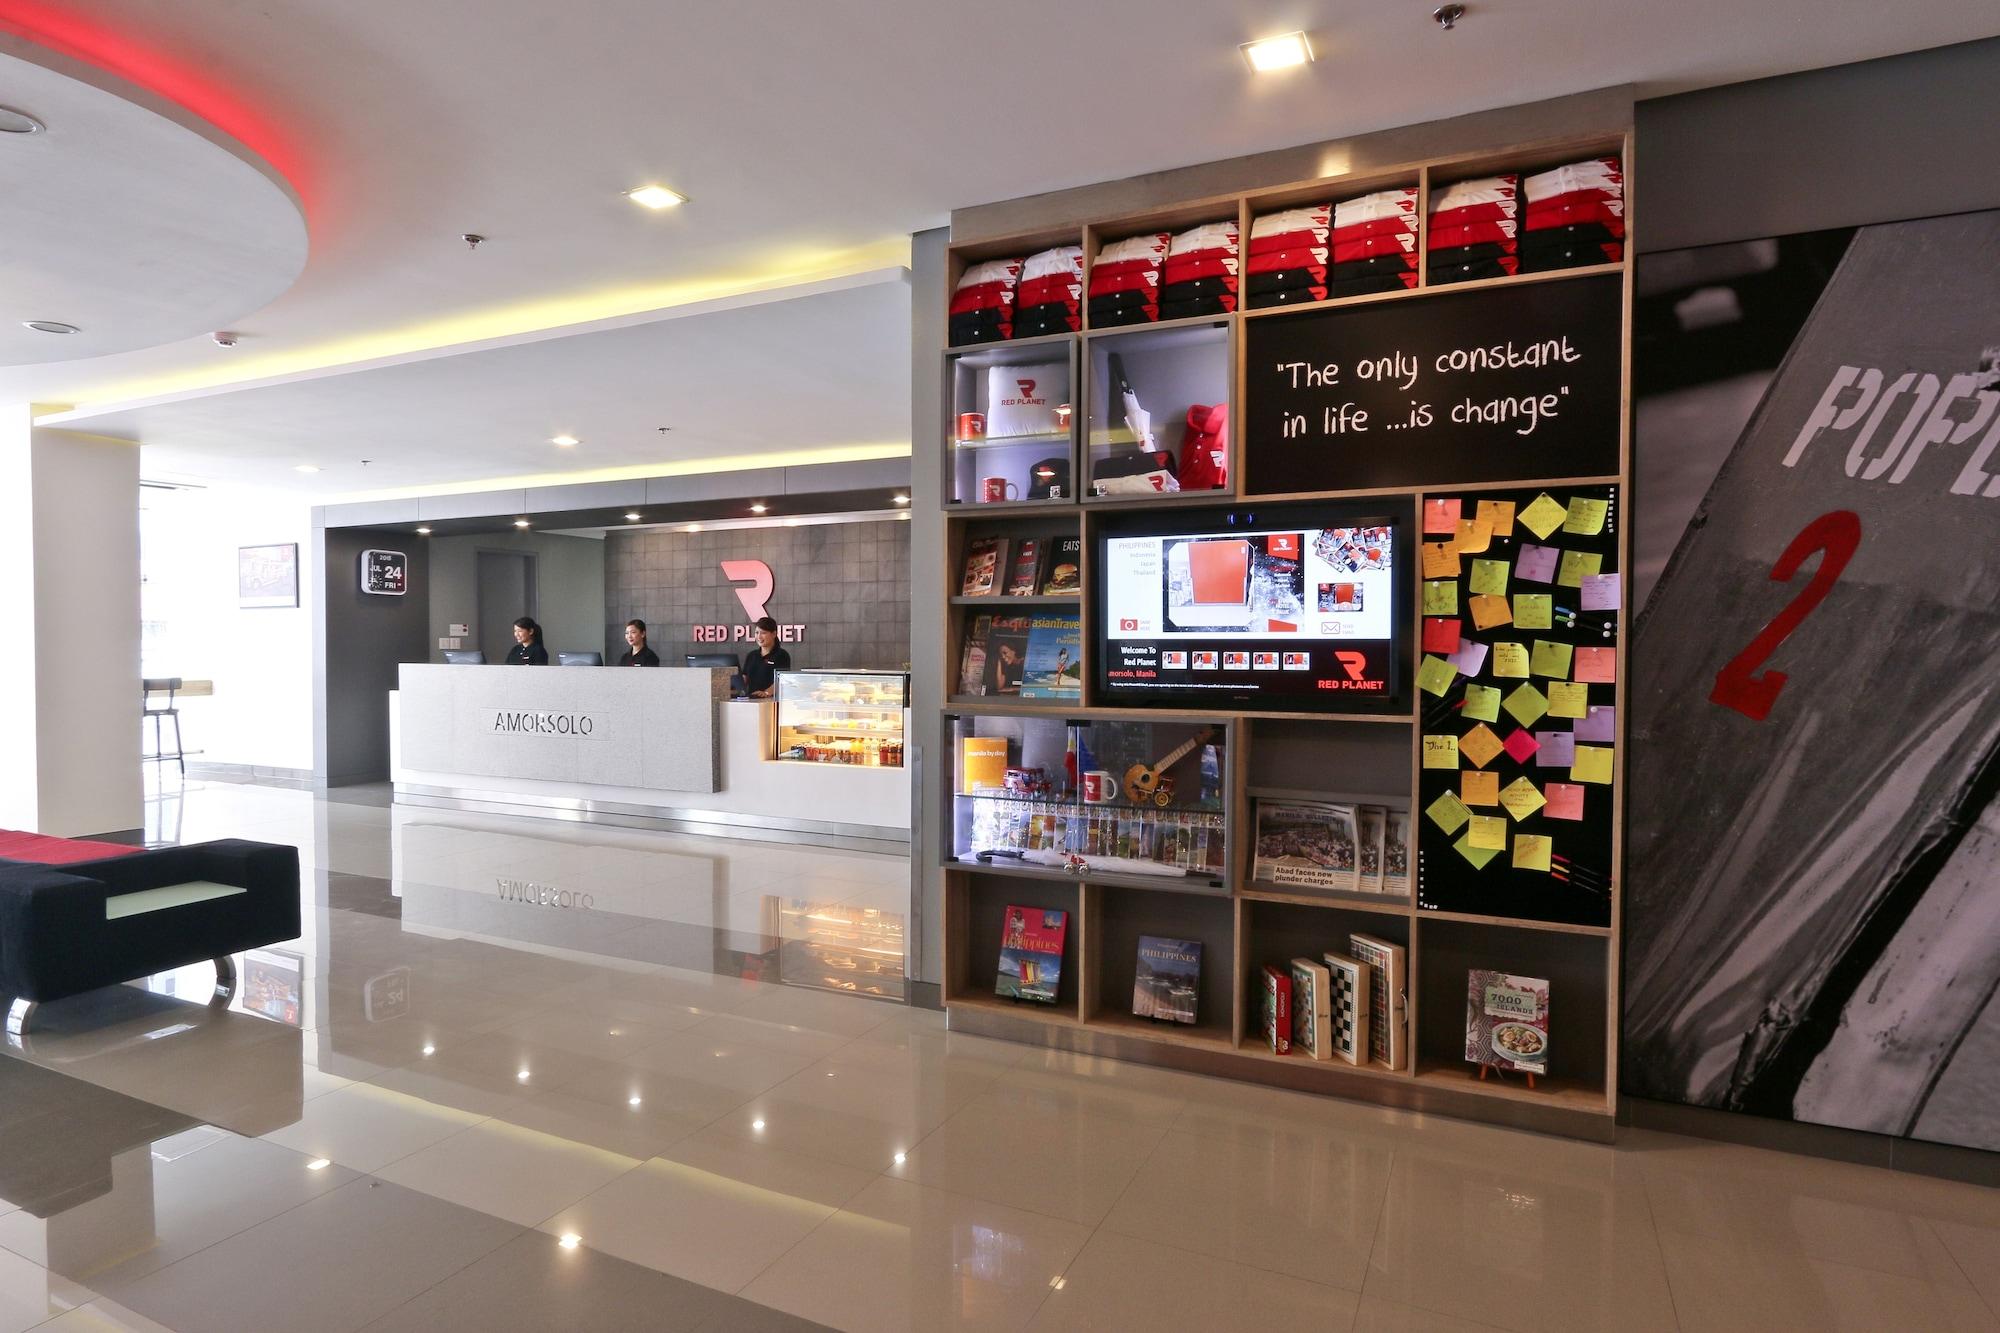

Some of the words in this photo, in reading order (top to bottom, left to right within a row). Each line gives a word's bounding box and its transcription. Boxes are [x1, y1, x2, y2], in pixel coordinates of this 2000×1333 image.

[1357, 350, 1418, 390] only
[1436, 335, 1581, 372] constant
[1017, 398, 1046, 406] PLANET
[1282, 411, 1306, 437] in
[1324, 402, 1368, 434] life
[1063, 541, 1080, 551] EATS
[385, 566, 402, 579] 24
[1709, 510, 1862, 721] 2
[693, 625, 728, 642] RED
[734, 624, 806, 643] PLNET
[1124, 658, 1136, 666] Red
[1137, 658, 1156, 666] Planet
[1108, 670, 1135, 679] morsolo,
[1136, 670, 1156, 678] Manila
[1318, 679, 1338, 690] RED
[1342, 680, 1384, 690] PLANET
[494, 712, 593, 736] AMORSOLO
[1275, 867, 1294, 875] Abad
[1295, 868, 1316, 877] faces
[1275, 874, 1303, 883] plunder
[1304, 877, 1334, 886] charges
[1141, 948, 1197, 963] PHILIPPINES
[1490, 993, 1522, 1005] 7000
[1496, 1004, 1533, 1015] ISLANDS
